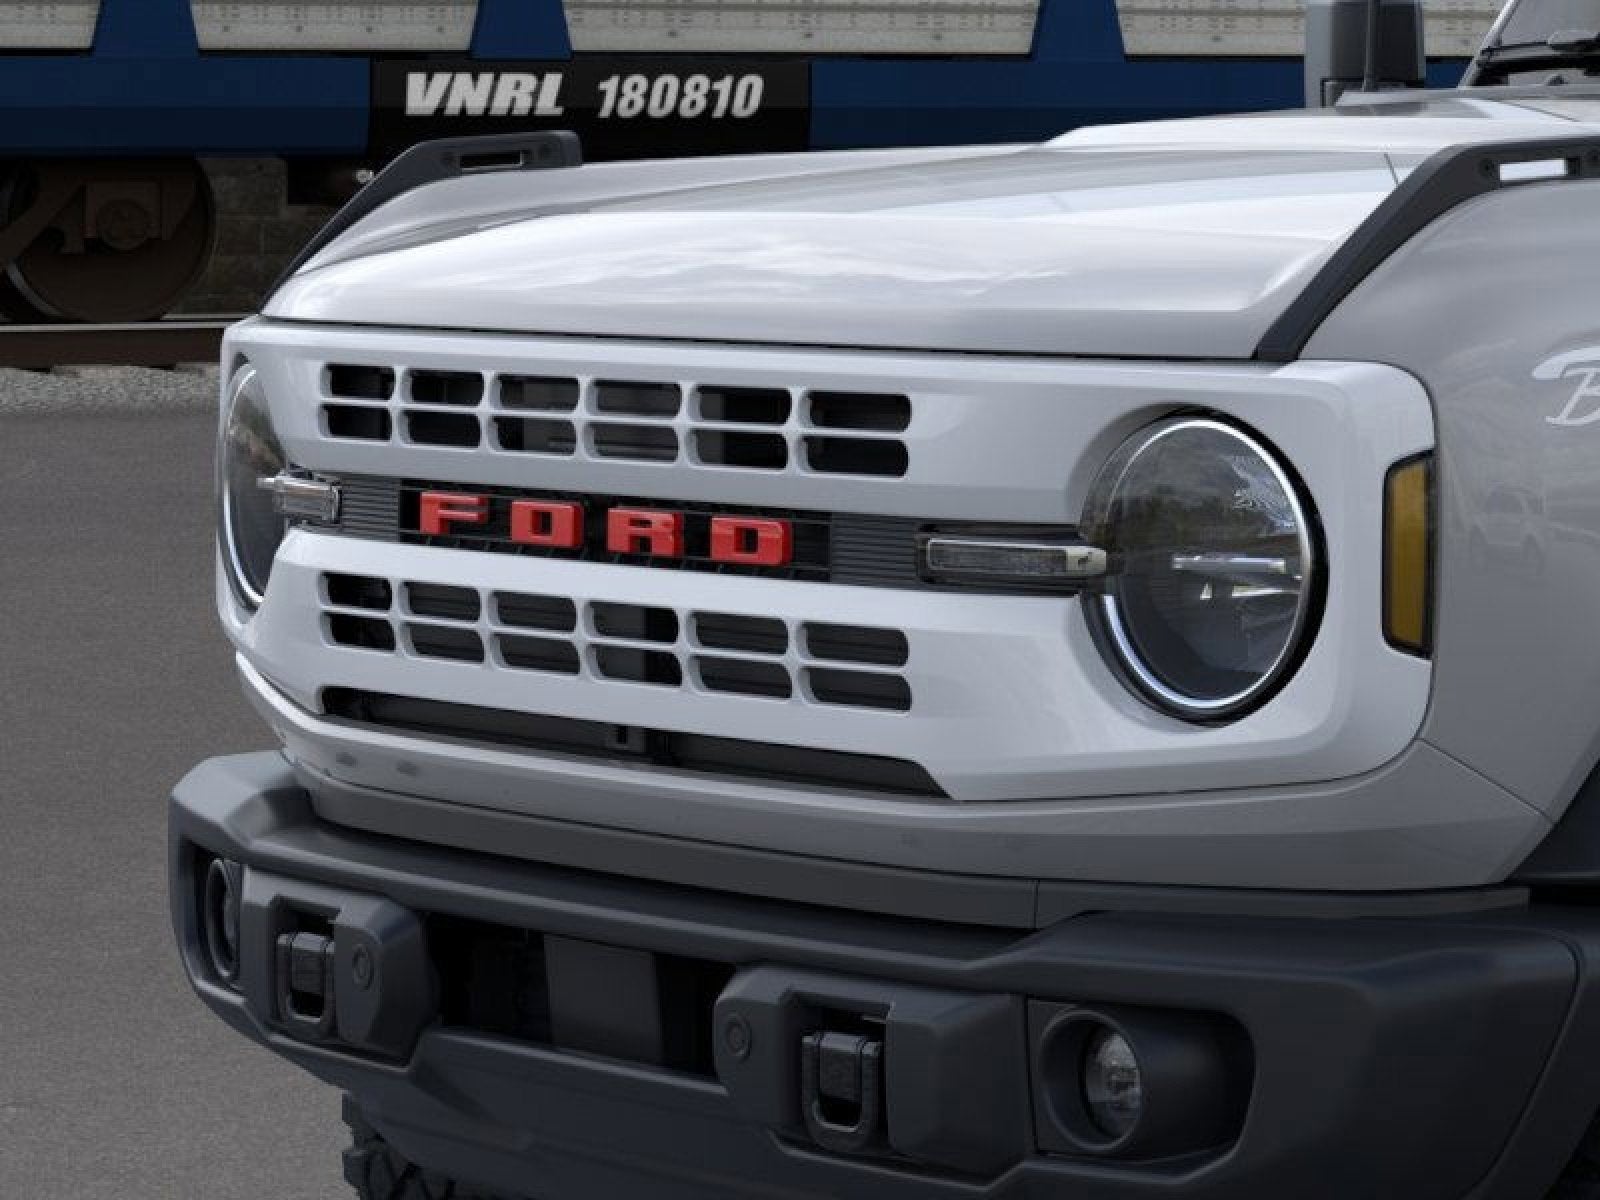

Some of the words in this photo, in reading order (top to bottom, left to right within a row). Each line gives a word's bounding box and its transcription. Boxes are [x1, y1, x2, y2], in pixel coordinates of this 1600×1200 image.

[405, 72, 563, 116] VNRL
[597, 74, 764, 118] 180810
[420, 491, 793, 567] FORD
